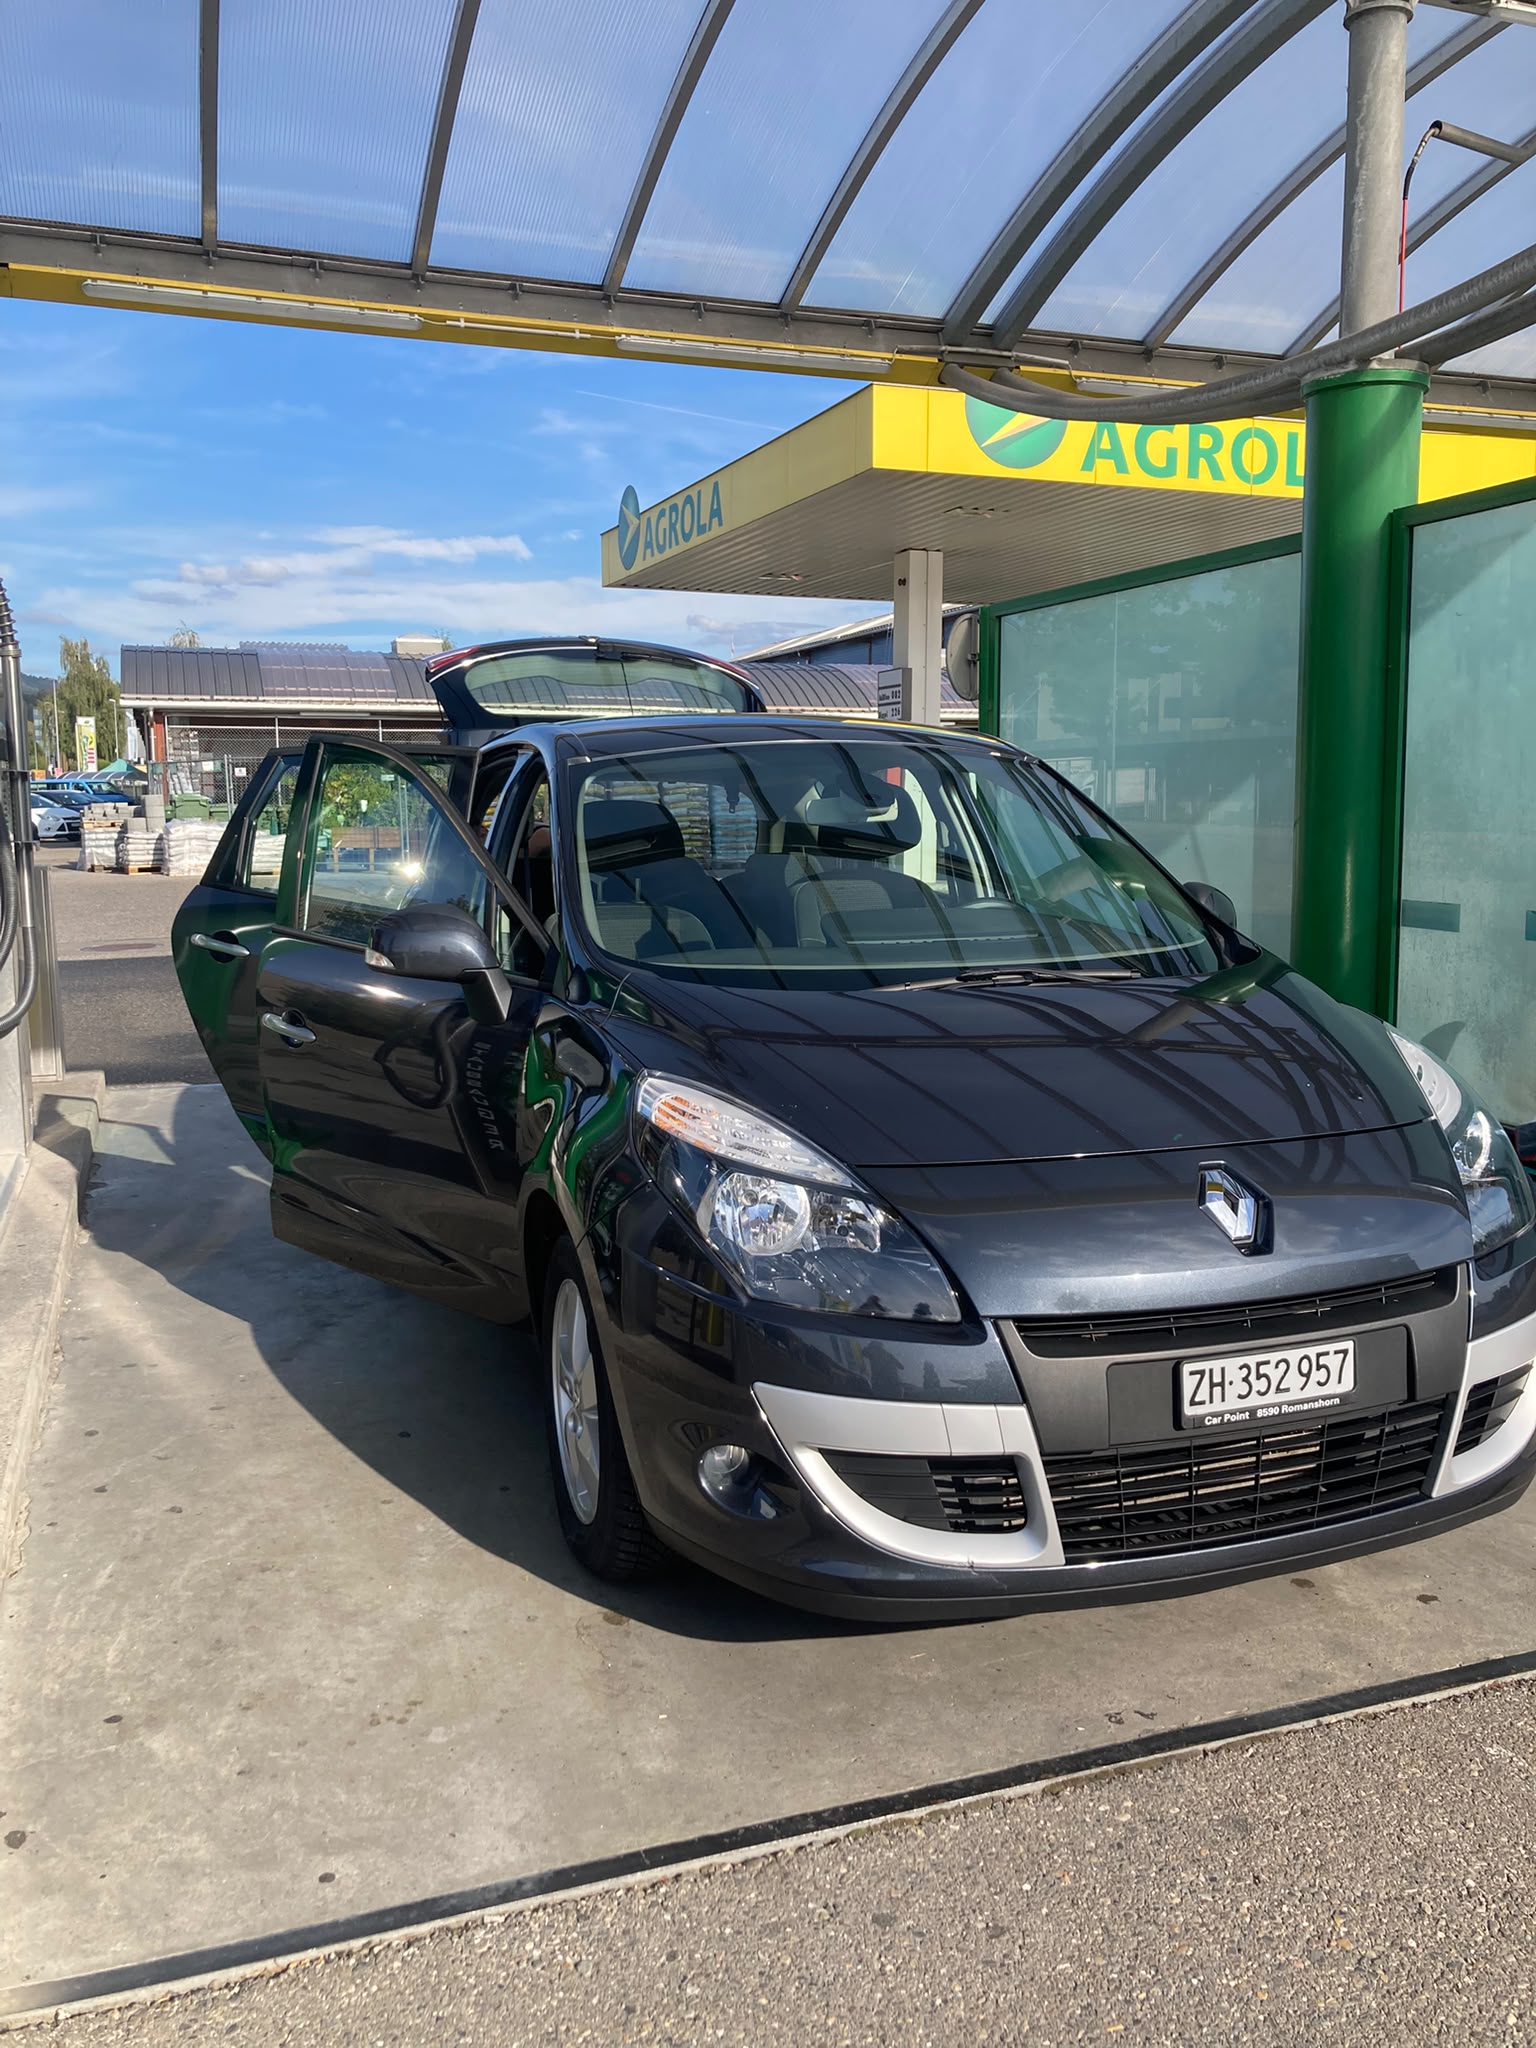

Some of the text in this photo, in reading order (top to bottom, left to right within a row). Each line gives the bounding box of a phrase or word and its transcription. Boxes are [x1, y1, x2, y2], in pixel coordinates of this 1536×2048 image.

[1080, 421, 1305, 488] AGROL
[642, 480, 724, 562] AGROLA
[1298, 1348, 1350, 1392] 957
[1204, 1397, 1341, 1425] Car Point 8590 Romanshorn
